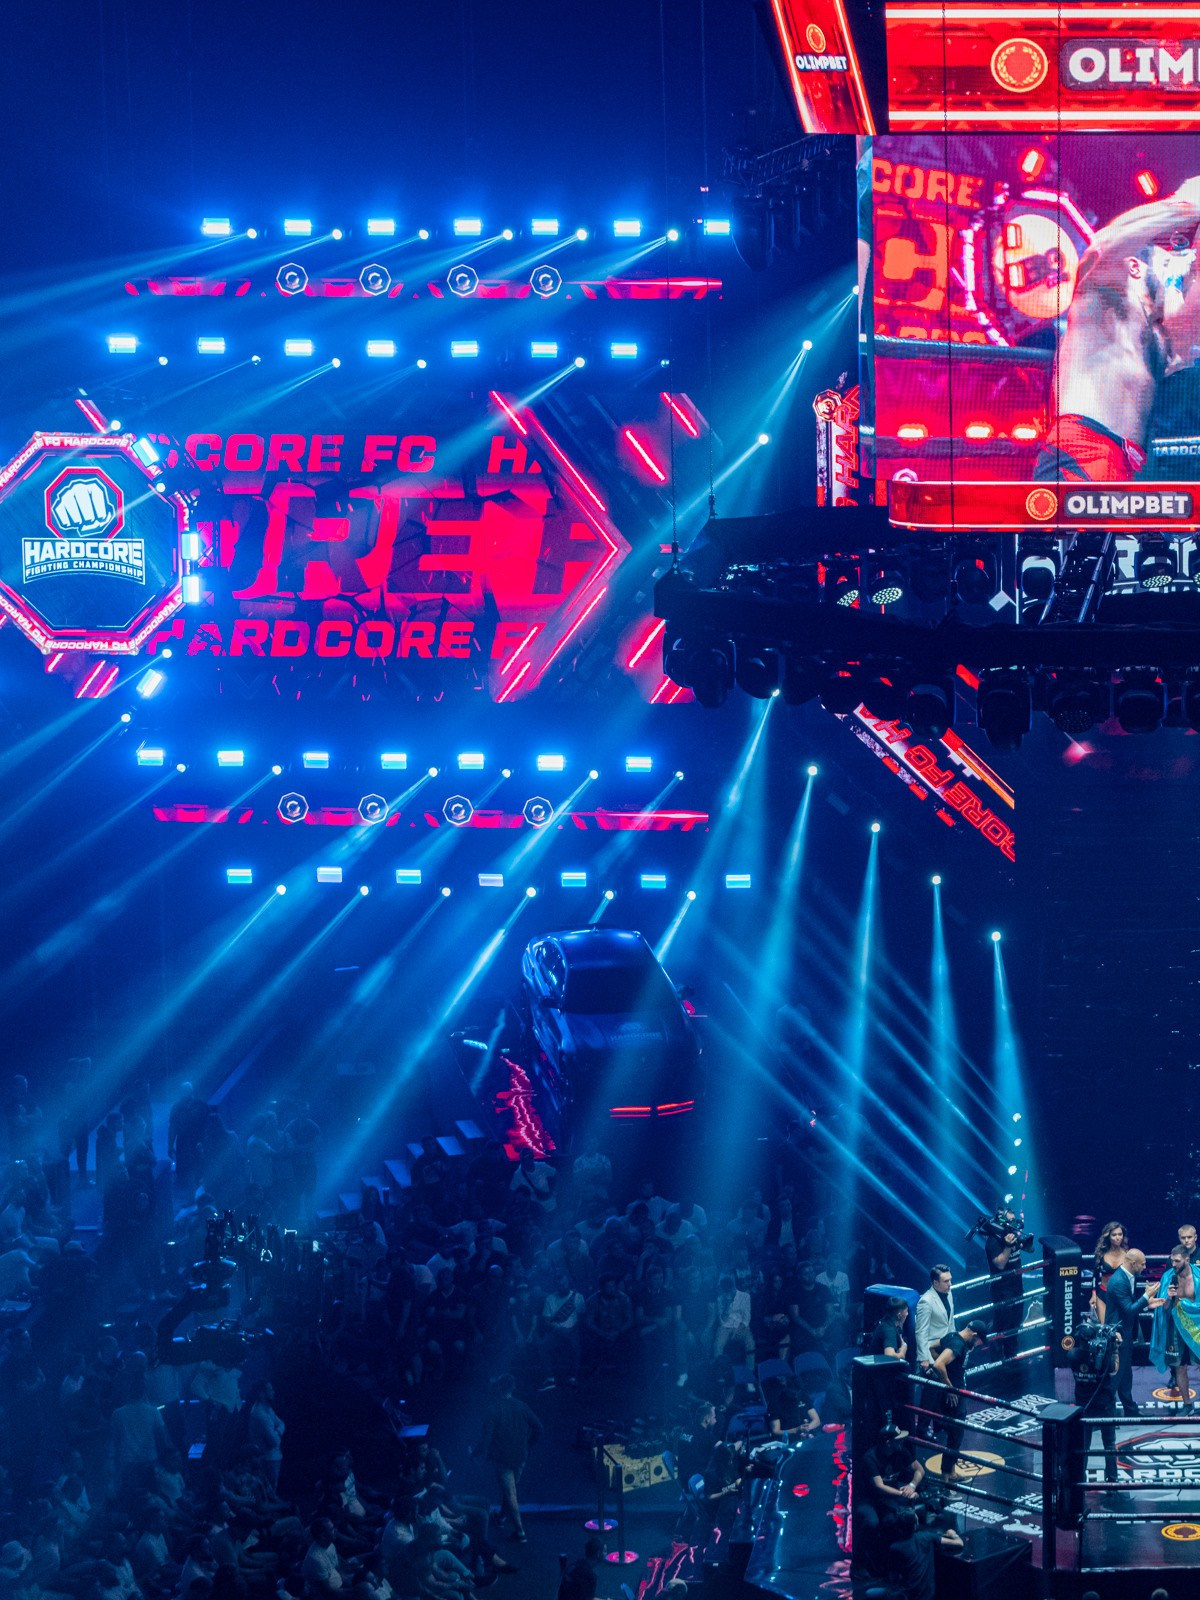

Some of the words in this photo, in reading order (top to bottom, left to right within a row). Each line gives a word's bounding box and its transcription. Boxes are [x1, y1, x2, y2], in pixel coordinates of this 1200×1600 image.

[795, 55, 848, 70] OLIMPBET
[872, 157, 984, 209] CORE
[44, 437, 62, 447] FC
[64, 437, 129, 448] HARDCORE
[186, 433, 345, 472] CORE
[361, 435, 437, 473] FC
[1067, 495, 1188, 514] OLIMPBET
[24, 541, 143, 567] HARDCORE
[25, 561, 69, 577] FIGHTING
[72, 560, 143, 578] CHAMPIONSHIP
[129, 602, 178, 648] HARDCORE
[46, 641, 109, 650] HARDCORE
[112, 641, 129, 650] FC
[904, 744, 955, 789] FC
[1064, 1280, 1073, 1335] OLIMPBET
